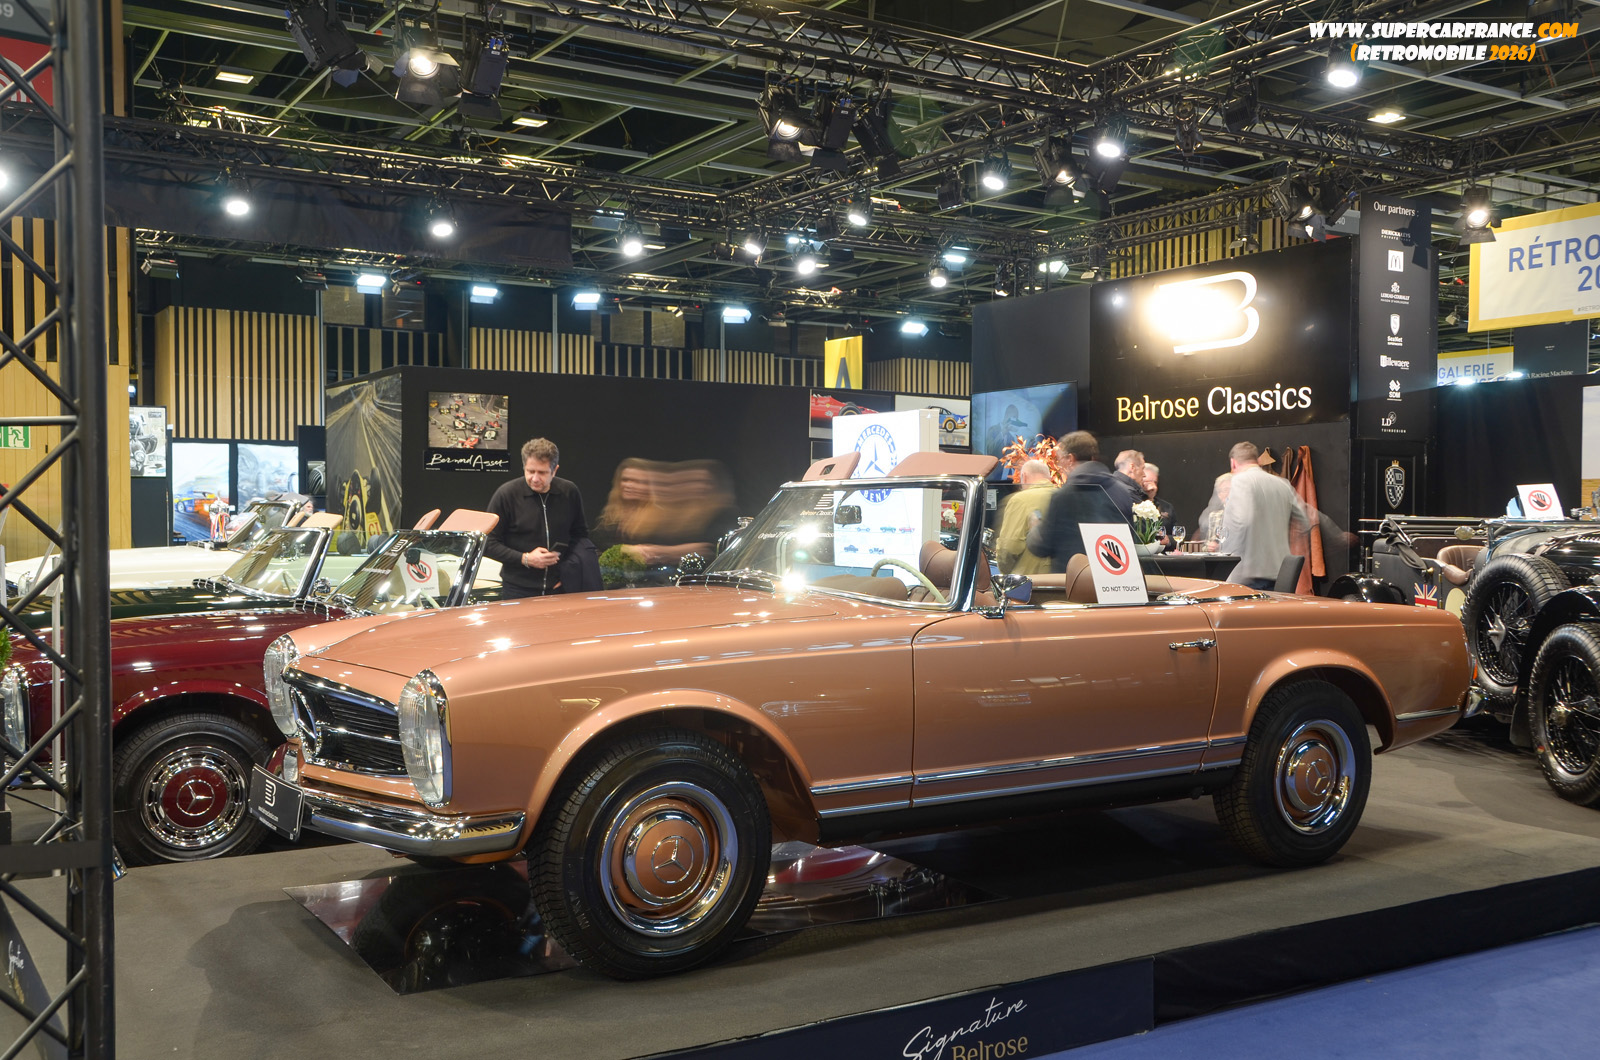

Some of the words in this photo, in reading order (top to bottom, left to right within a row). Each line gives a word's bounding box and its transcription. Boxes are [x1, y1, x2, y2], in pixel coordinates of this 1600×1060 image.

[1373, 200, 1387, 212] Our
[1508, 234, 1600, 273] RÉTRO
[1438, 363, 1495, 379] GALERIE
[1116, 394, 1200, 423] Belrose
[1206, 382, 1313, 416] Classics
[857, 424, 894, 445] MERCEDES
[902, 996, 1028, 1060] Signature
[951, 1035, 1029, 1060] Belrose
